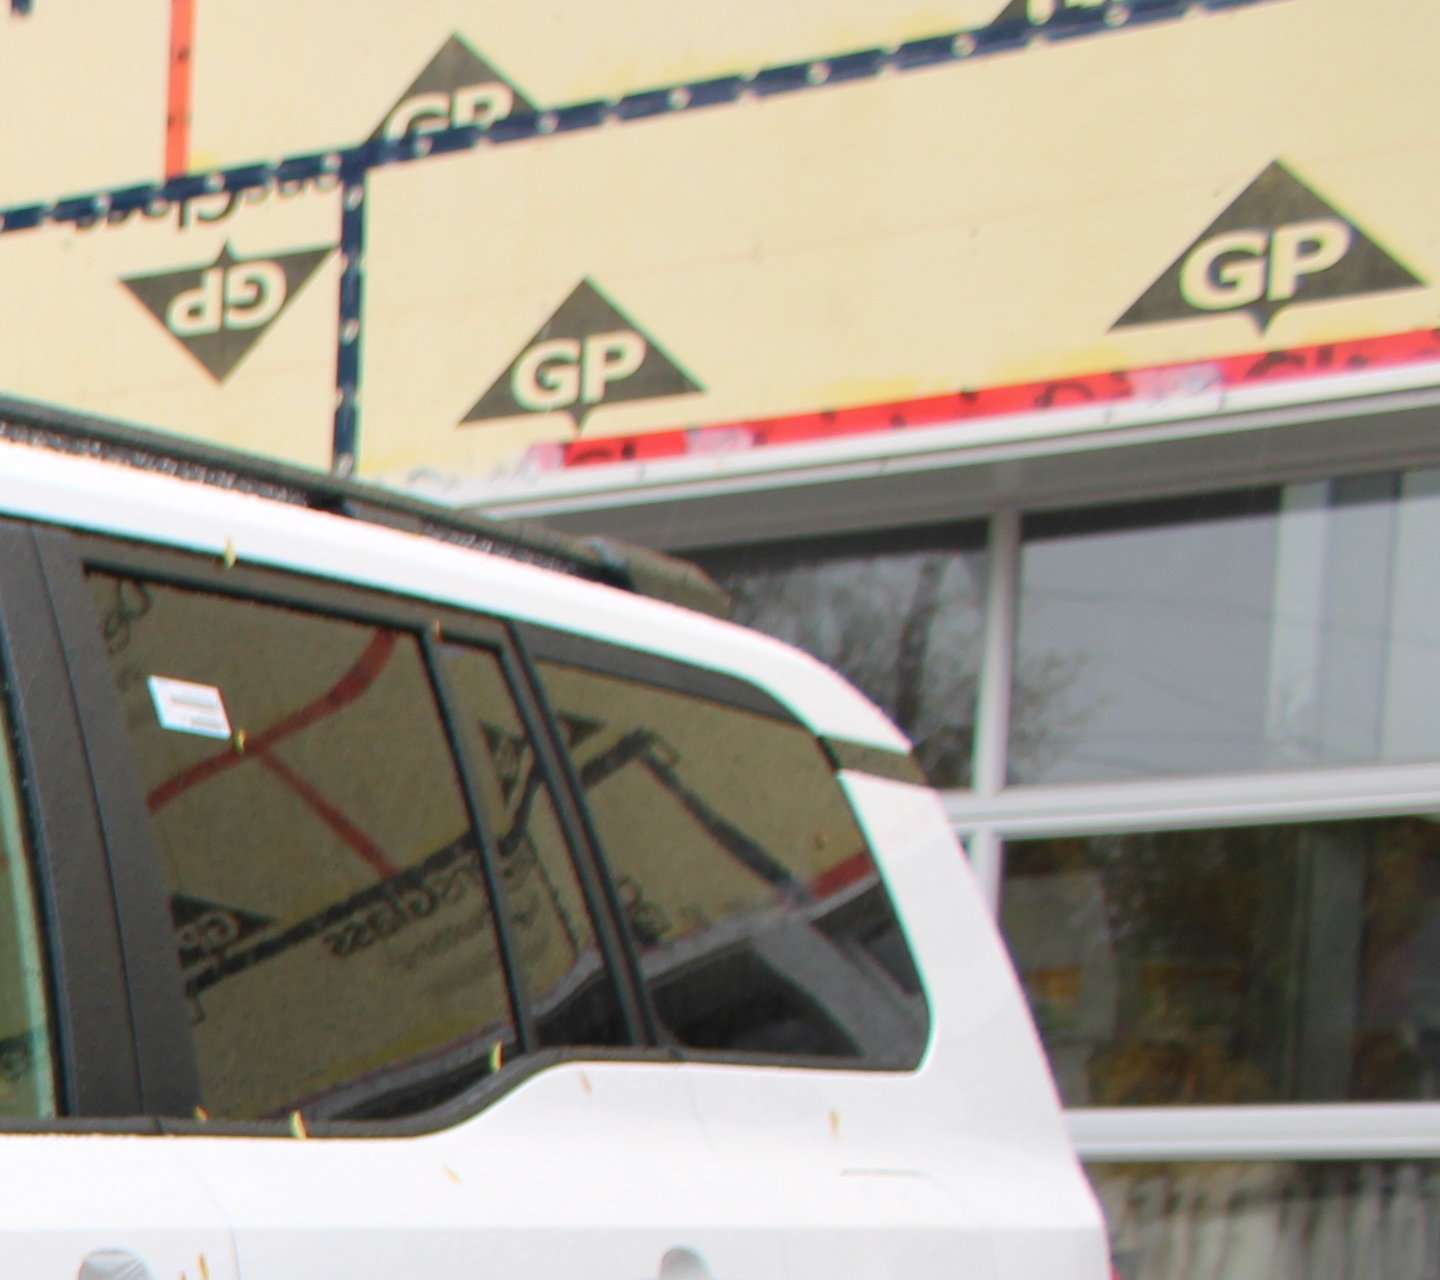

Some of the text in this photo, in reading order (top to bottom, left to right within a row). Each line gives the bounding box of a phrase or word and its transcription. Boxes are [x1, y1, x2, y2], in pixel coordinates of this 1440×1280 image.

[166, 261, 288, 337] GP
[1178, 216, 1352, 311] GP
[511, 330, 647, 411] GP
